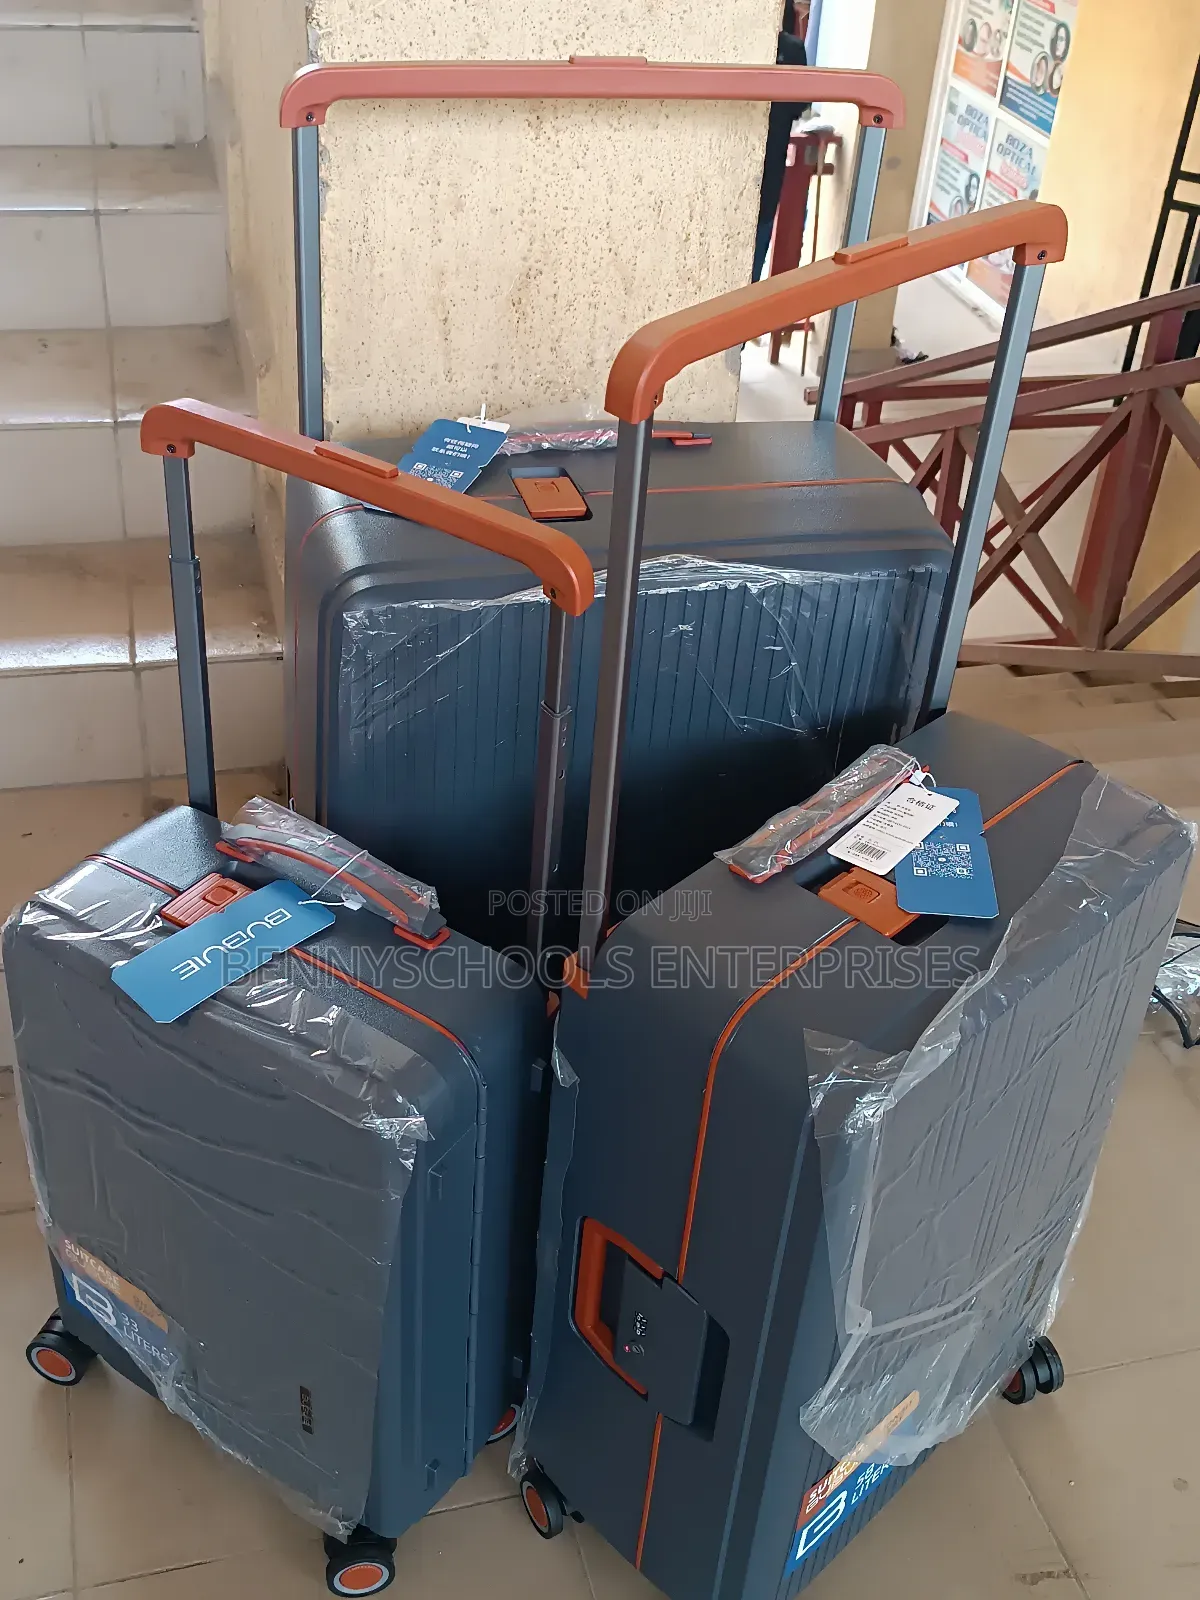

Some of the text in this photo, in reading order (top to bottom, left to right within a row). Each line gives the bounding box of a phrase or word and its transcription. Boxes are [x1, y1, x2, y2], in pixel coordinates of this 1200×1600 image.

[957, 114, 989, 142] OPTICA
[1005, 134, 1034, 159] BOZA
[64, 1239, 120, 1284] SUITCASE
[123, 1326, 171, 1366] LITERS
